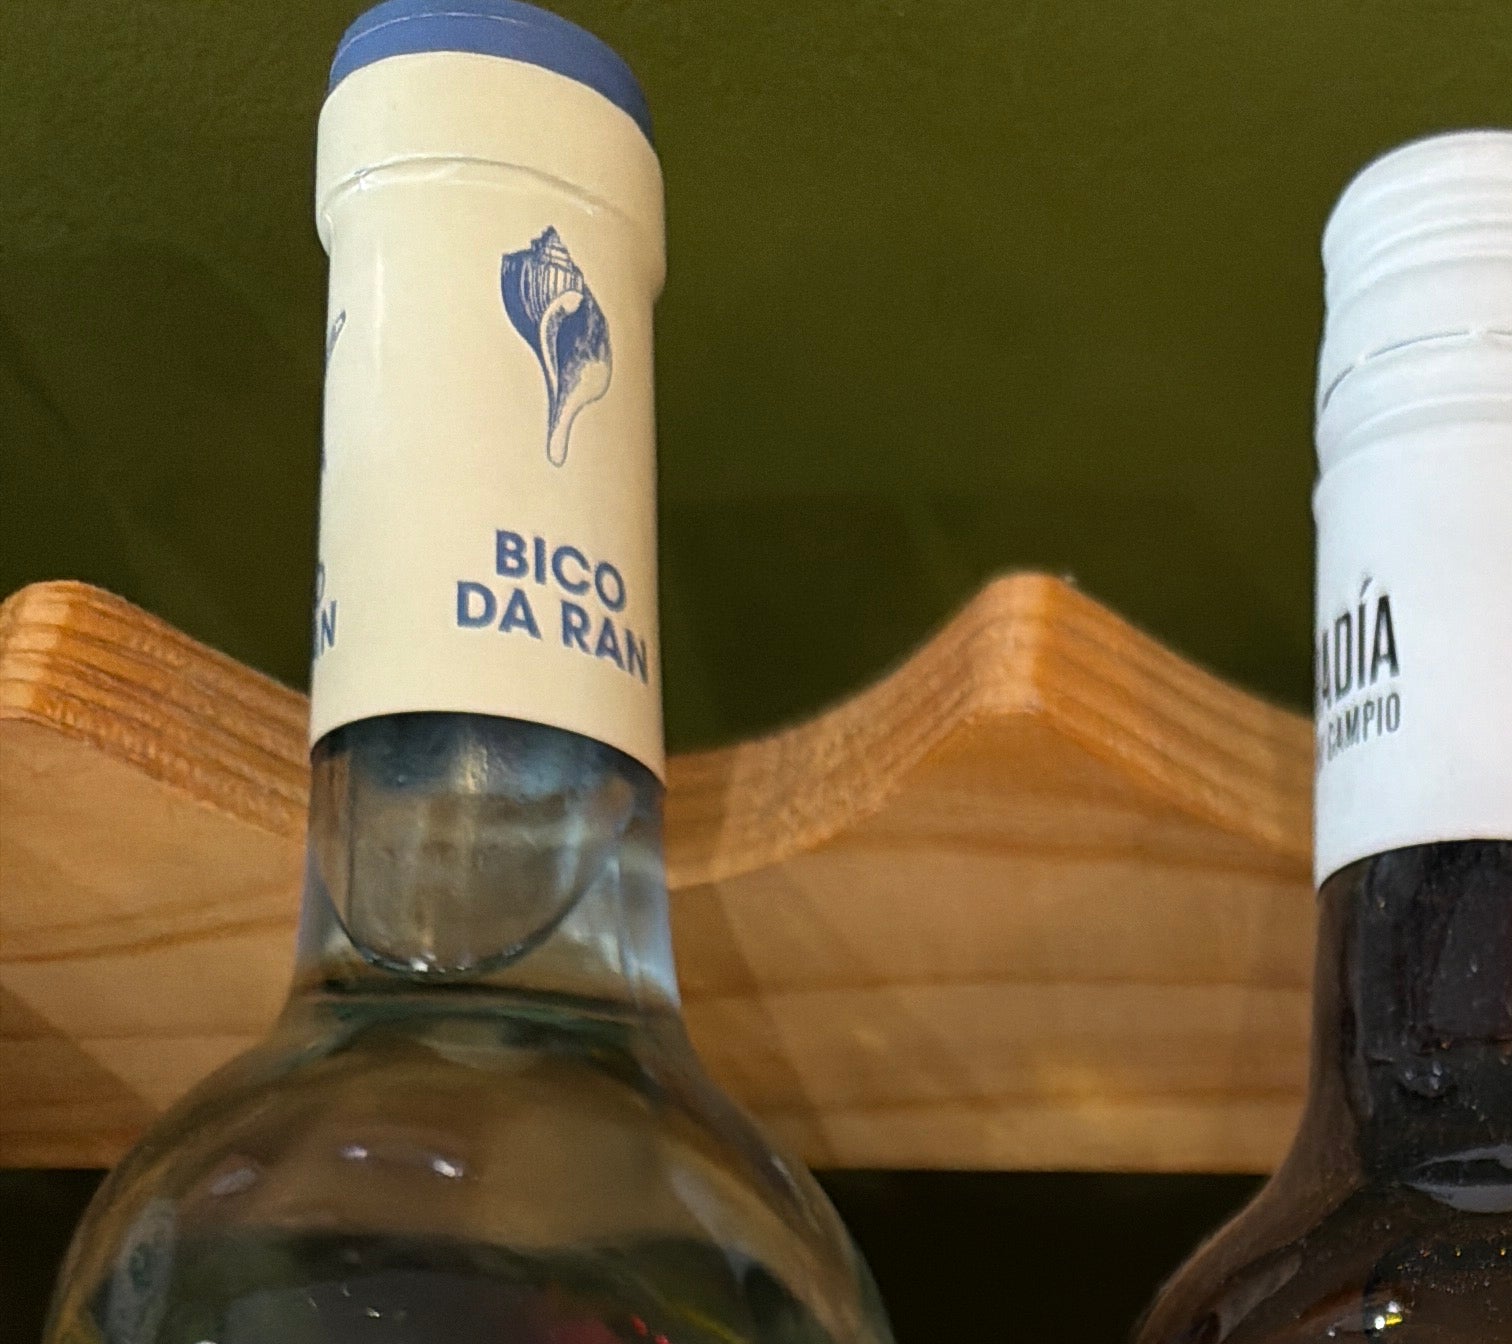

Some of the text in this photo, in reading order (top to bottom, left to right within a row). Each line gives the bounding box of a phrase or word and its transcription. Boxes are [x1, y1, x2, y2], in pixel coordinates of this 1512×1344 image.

[496, 529, 627, 612] BICO
[457, 580, 649, 686] DA RAN
[1322, 576, 1400, 710] ADÍA
